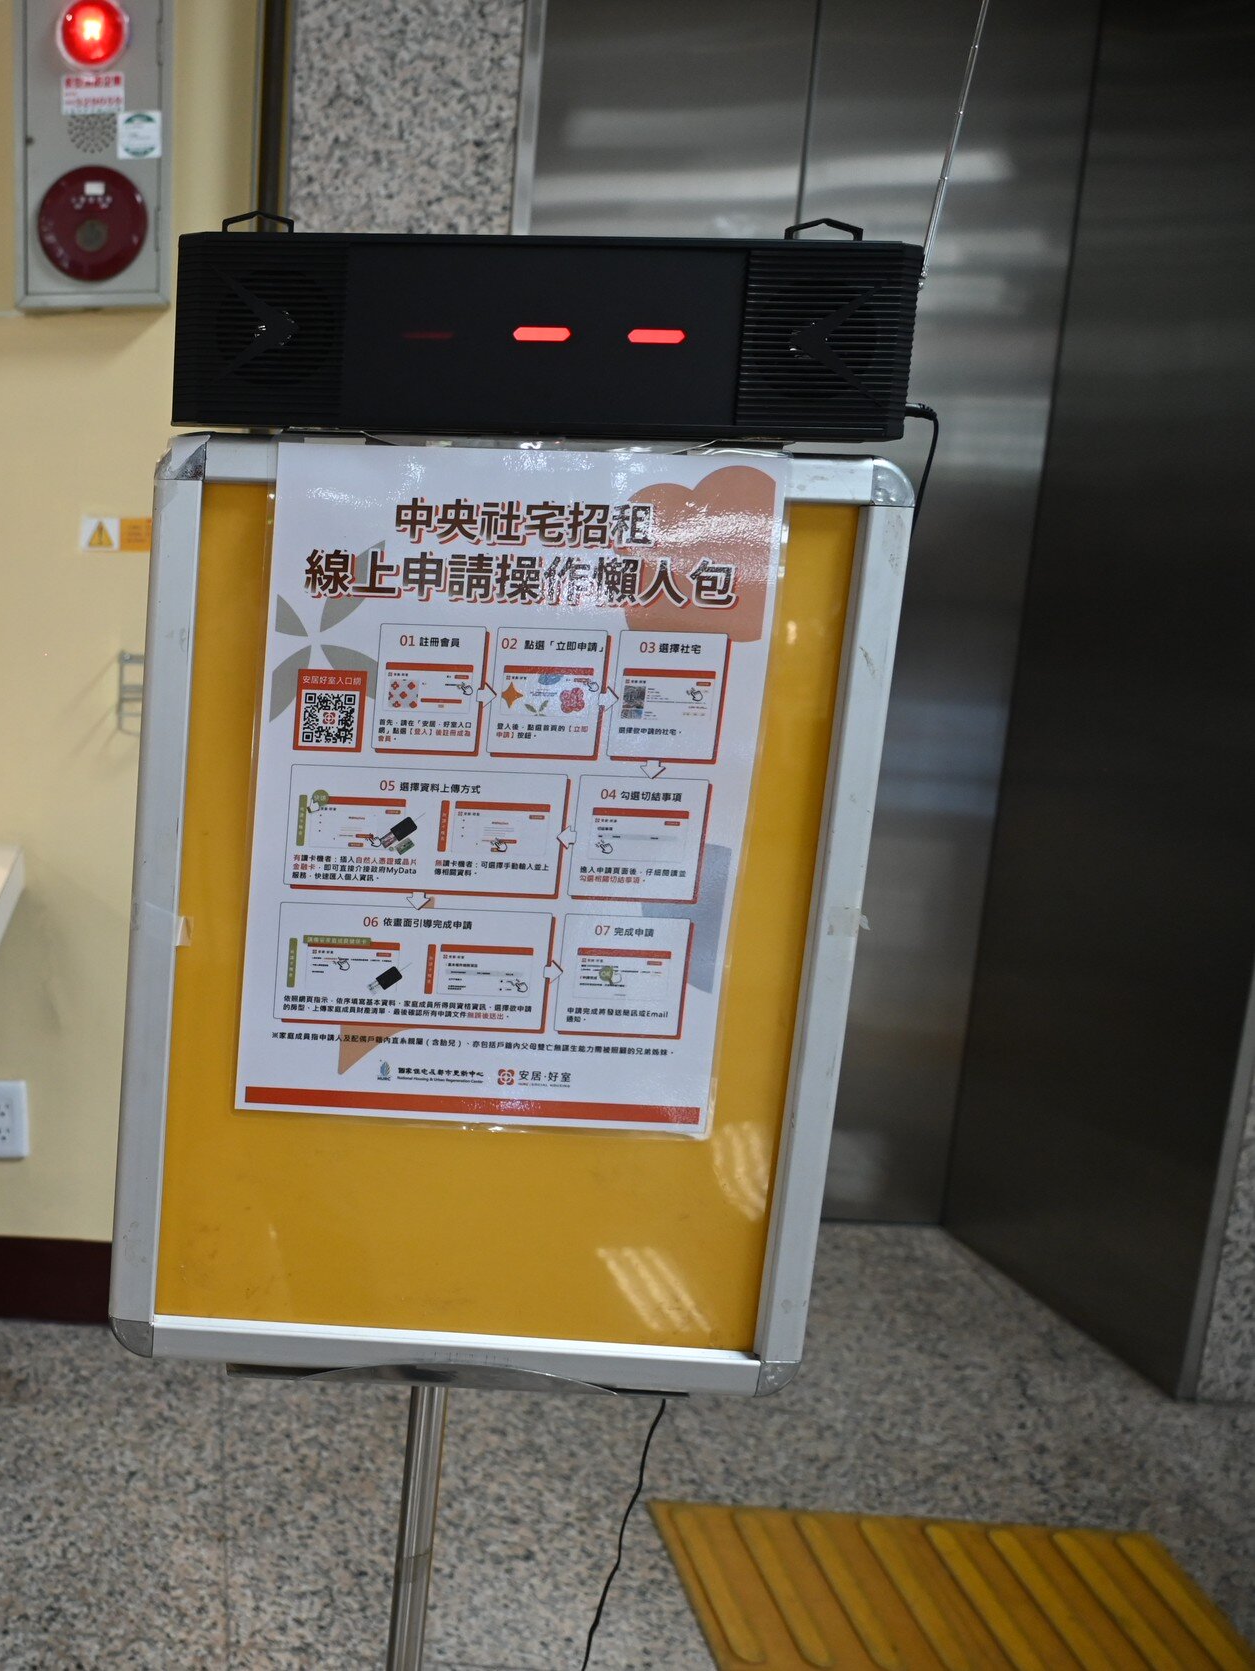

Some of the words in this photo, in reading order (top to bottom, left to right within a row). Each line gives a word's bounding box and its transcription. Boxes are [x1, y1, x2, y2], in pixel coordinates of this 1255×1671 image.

[395, 497, 653, 547] 中央社宅招租
[305, 549, 737, 607] 線上申請操作懶人包
[400, 635, 415, 647] 01
[419, 637, 460, 648] 註冊會員
[501, 637, 518, 650] 02
[640, 641, 656, 653] 03
[658, 643, 702, 655] 選擇社宅
[302, 675, 362, 686] 安居好室入口網
[379, 780, 395, 791] 05
[400, 781, 481, 794] 選擇資料上傳方式
[601, 788, 617, 800] 04
[620, 791, 682, 802] 勾選切結事項
[363, 916, 379, 927] 06
[383, 917, 473, 930] 依畫面引導完成申請
[594, 925, 611, 936] 07
[614, 927, 654, 938] 完成申請
